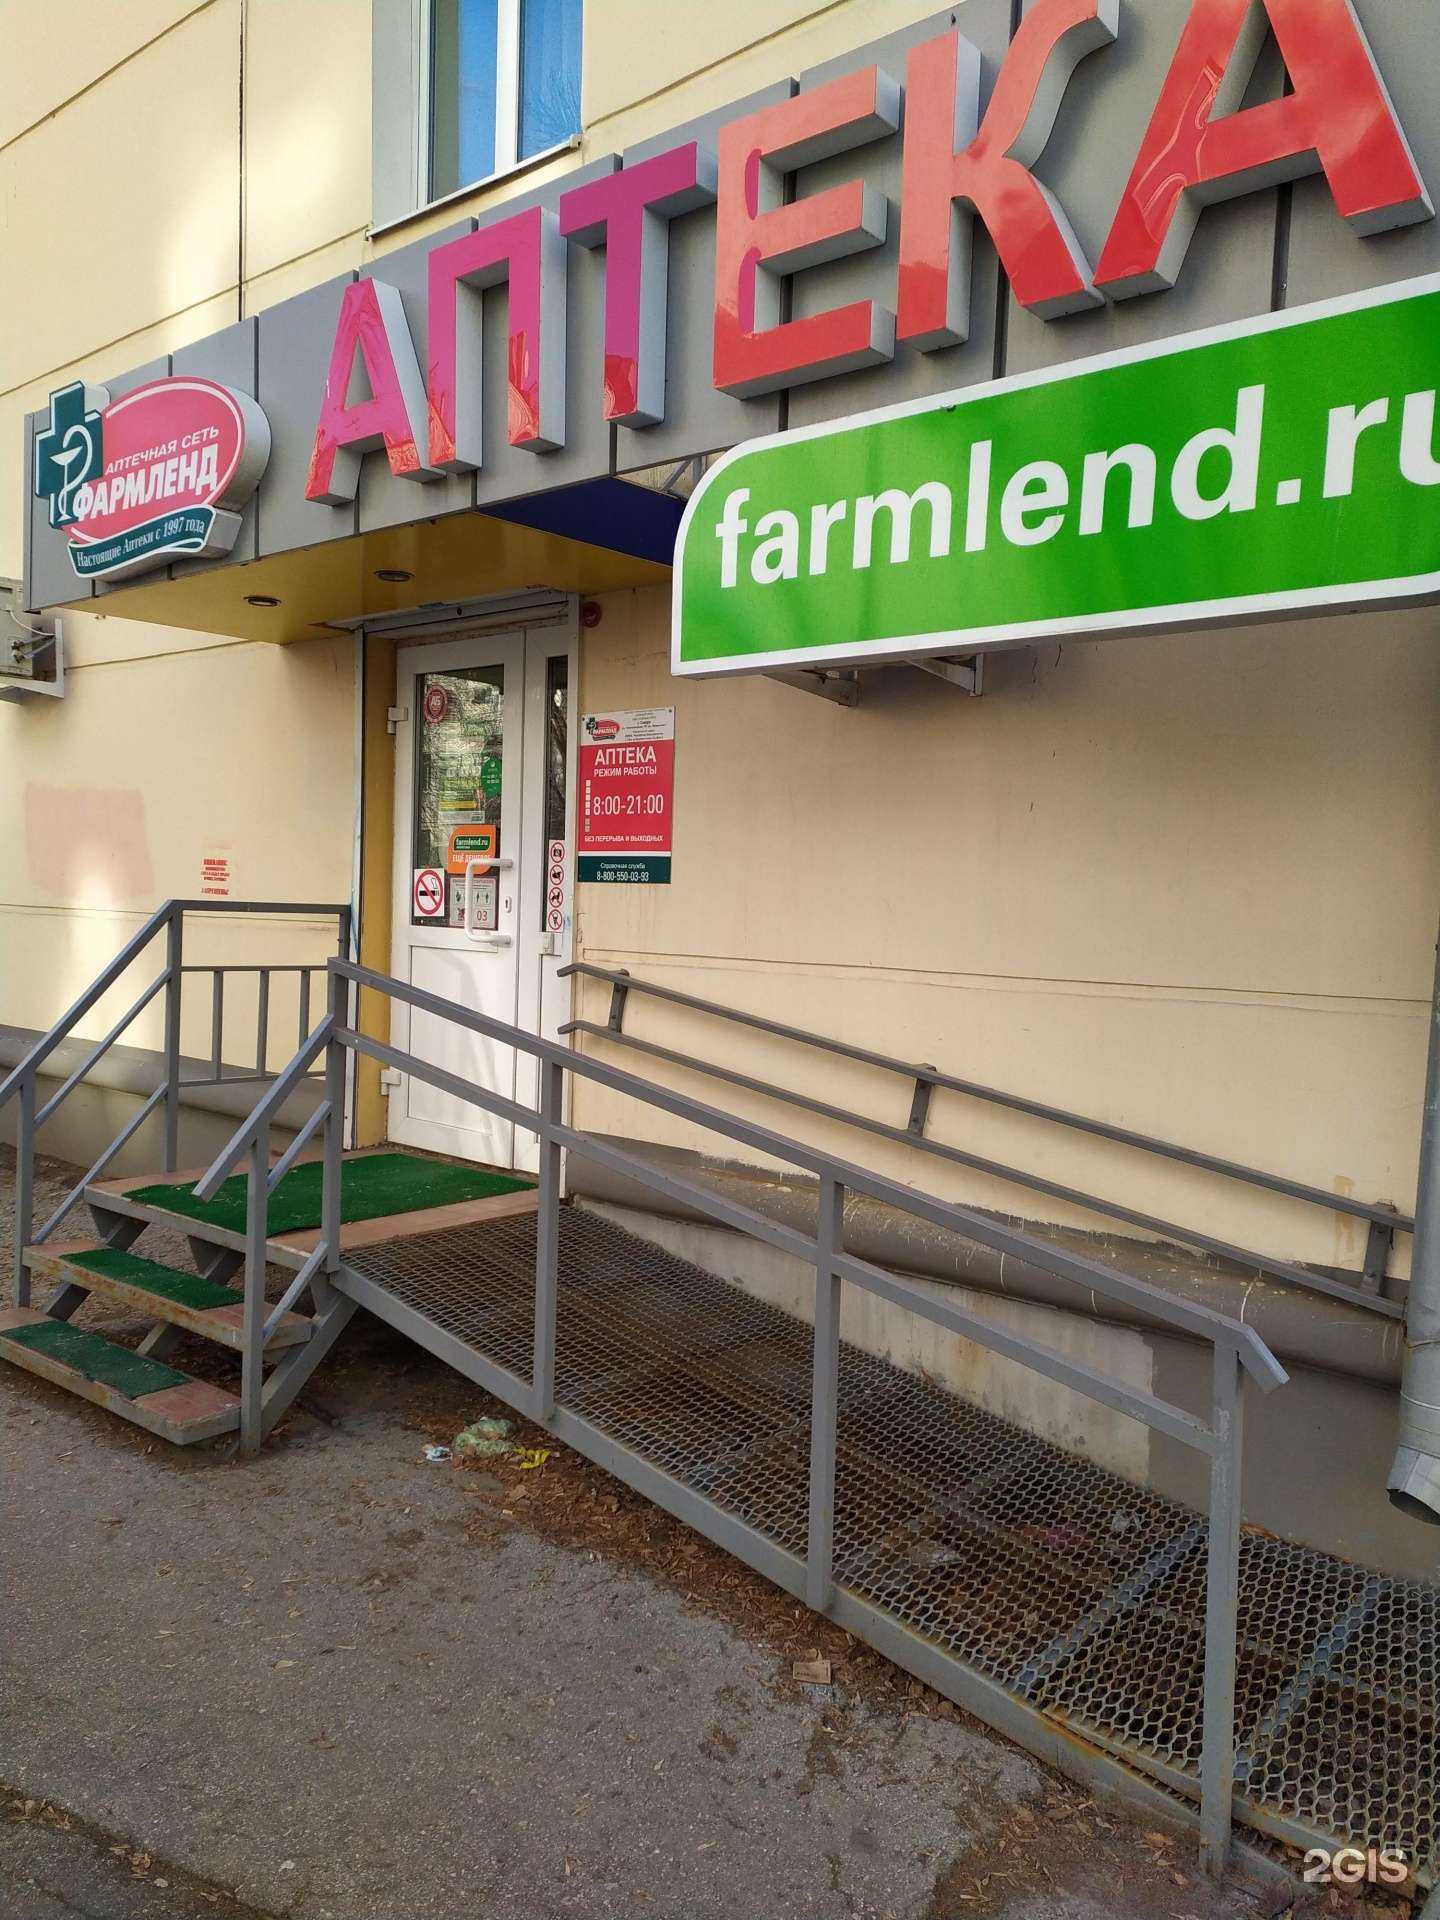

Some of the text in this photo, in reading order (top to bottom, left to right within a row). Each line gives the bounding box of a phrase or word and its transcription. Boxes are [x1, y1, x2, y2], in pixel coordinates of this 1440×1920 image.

[305, 0, 1432, 504] АПТЕКА
[105, 426, 219, 475] АПТЕЧНАЯ СЕТЬ
[73, 443, 218, 521] ФАРМЛЕНД
[77, 516, 205, 568] Настоящие Аптеки с 1997 года
[593, 765, 657, 777] РЕЖИМ РАБОТЫ
[595, 746, 656, 766] АПТЕКА
[593, 794, 664, 816] 8:00-21:00
[477, 910, 488, 921] 03
